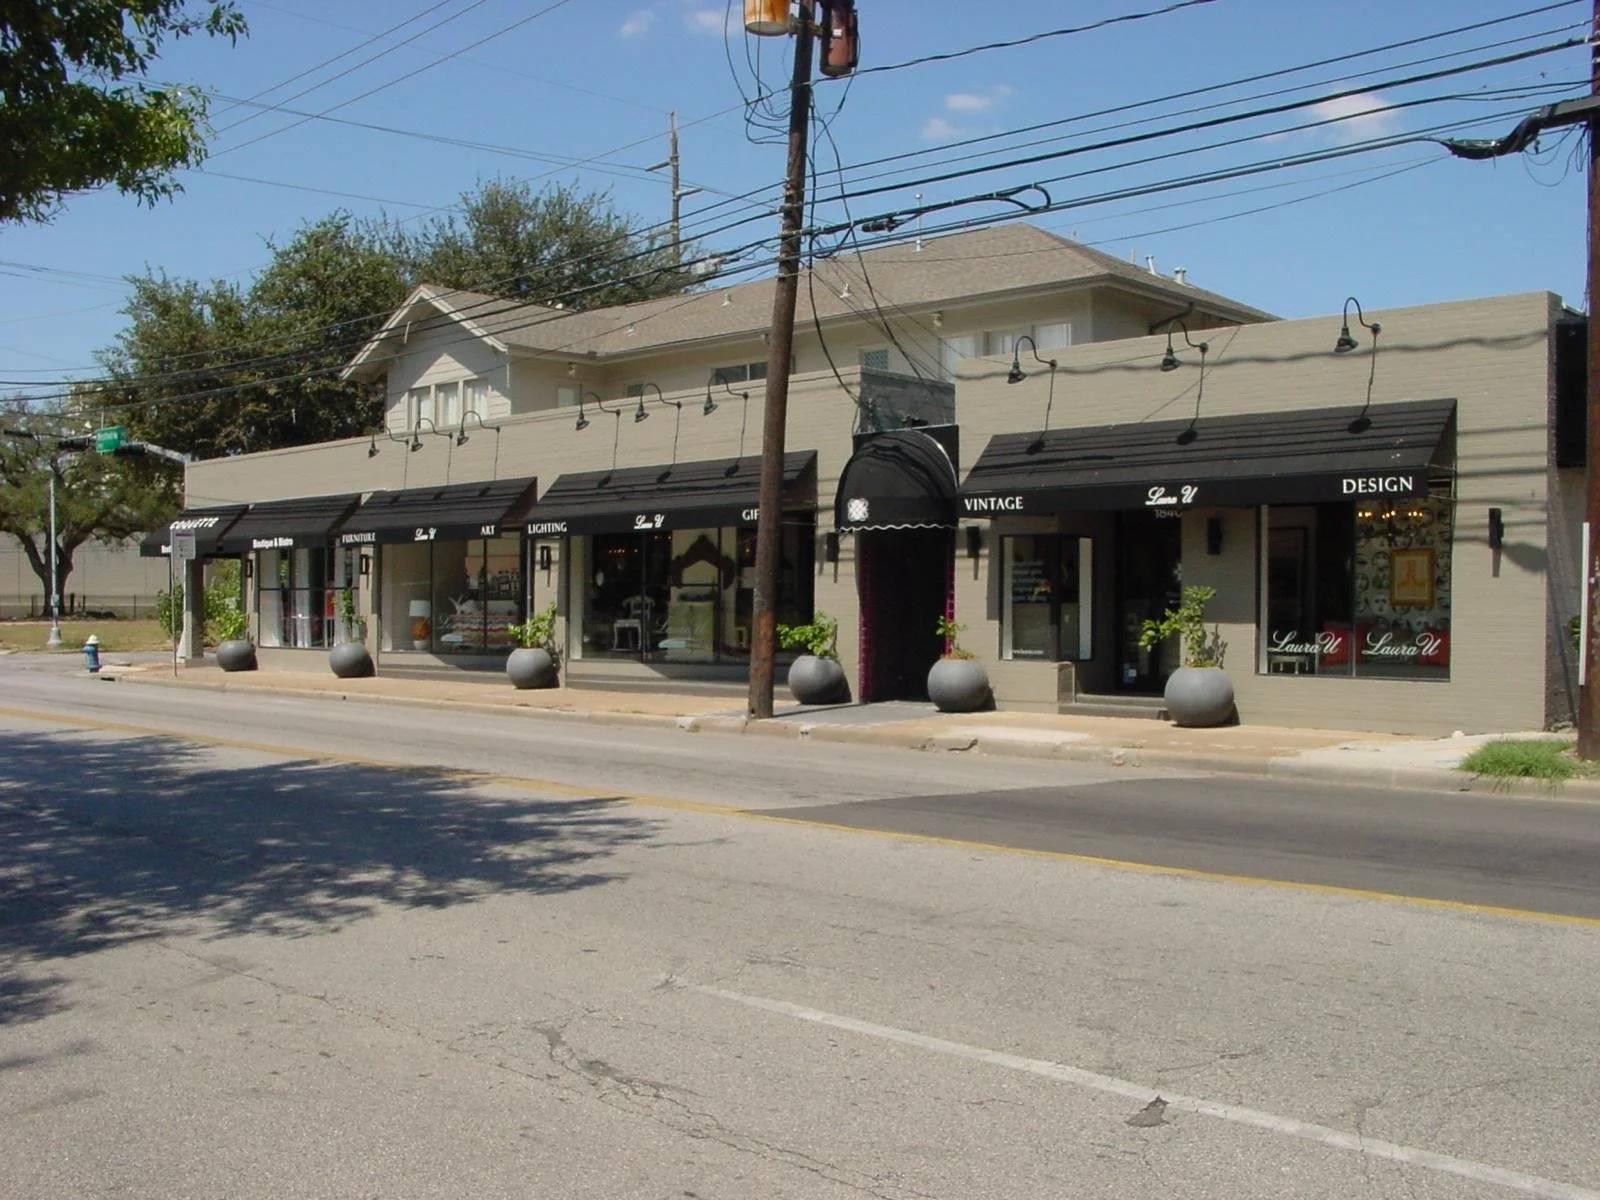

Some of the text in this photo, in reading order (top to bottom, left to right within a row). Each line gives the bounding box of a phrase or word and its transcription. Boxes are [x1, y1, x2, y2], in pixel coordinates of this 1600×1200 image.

[1342, 476, 1413, 494] DESIGN
[964, 496, 1024, 511] VINTAGE
[741, 508, 760, 521] GIF
[481, 525, 495, 537] ART
[527, 521, 568, 534] LIGHTING
[341, 532, 376, 545] FURNITURE
[1268, 630, 1343, 655] Laura U
[1362, 631, 1442, 656] Laura U
